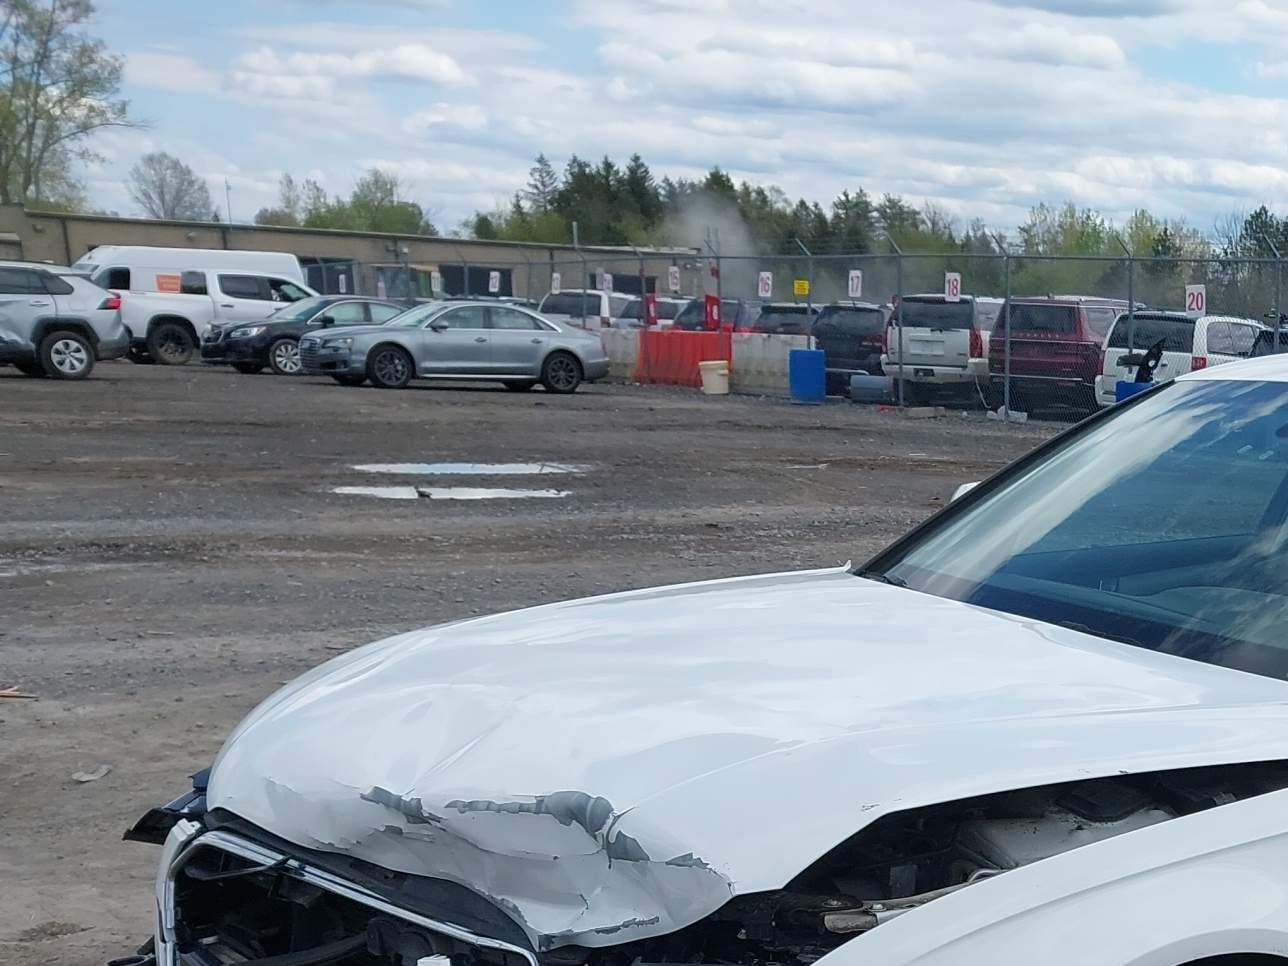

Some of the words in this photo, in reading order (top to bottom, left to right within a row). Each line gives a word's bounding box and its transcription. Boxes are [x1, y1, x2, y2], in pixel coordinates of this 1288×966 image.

[759, 276, 771, 293] 16
[850, 275, 860, 293] 17
[947, 278, 959, 297] 18
[1187, 291, 1204, 311] 20
